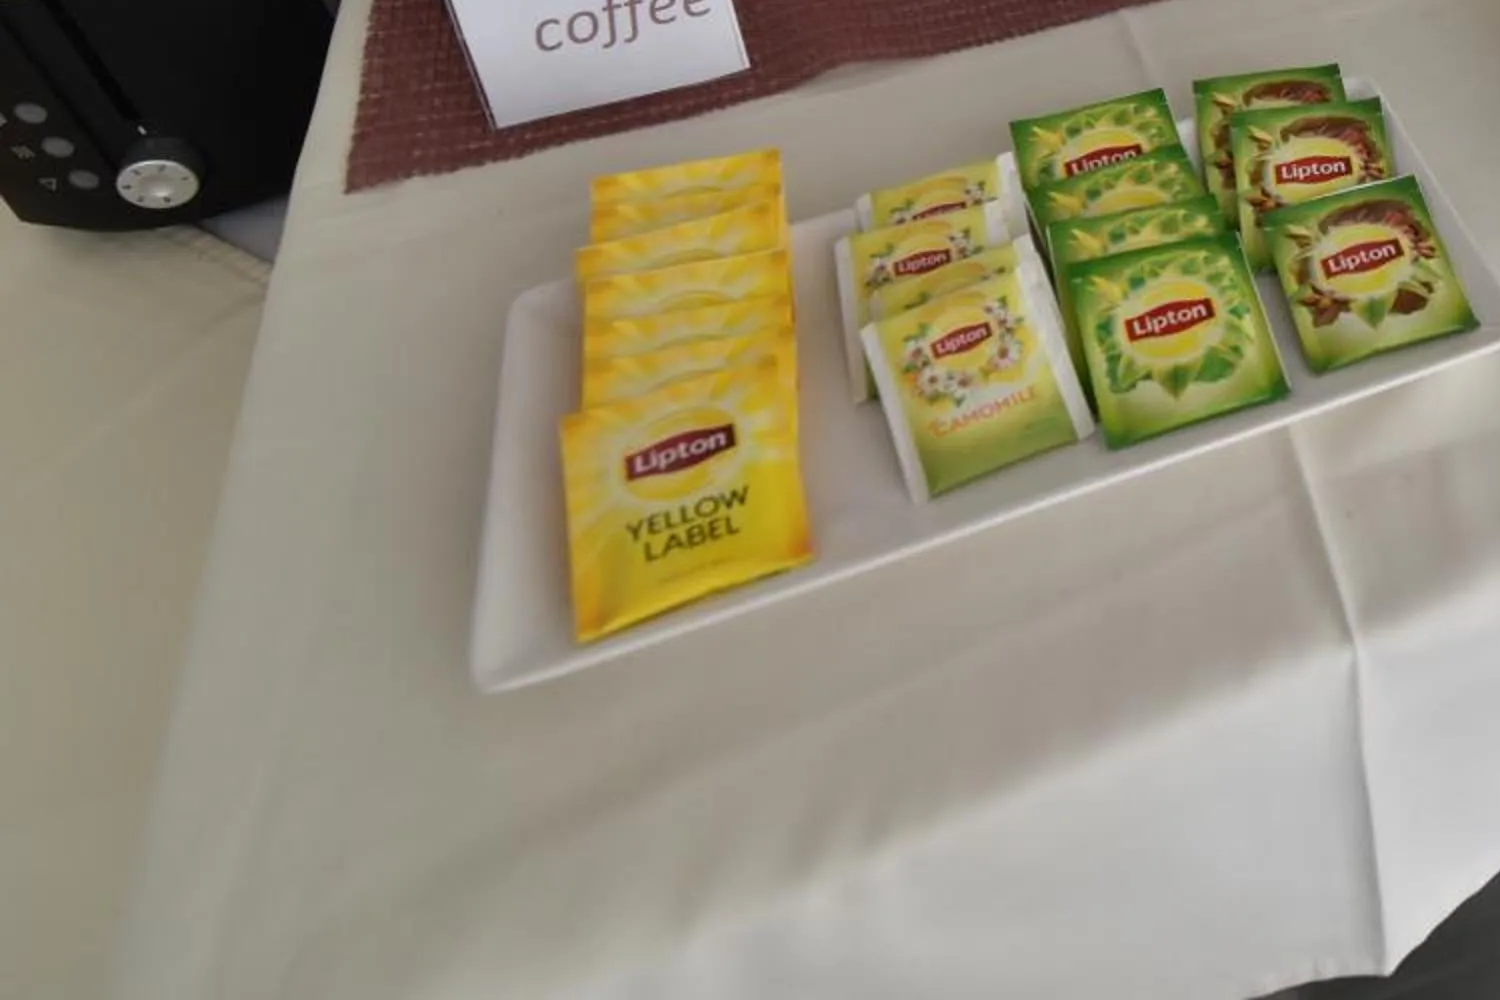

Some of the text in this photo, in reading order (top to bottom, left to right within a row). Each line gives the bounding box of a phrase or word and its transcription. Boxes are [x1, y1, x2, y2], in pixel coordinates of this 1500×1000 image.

[1281, 160, 1347, 181] Lipton
[896, 252, 948, 273] Lipton
[1327, 243, 1397, 273] Lipton
[1132, 303, 1208, 336] Lipton
[935, 326, 989, 355] Lipton
[633, 430, 728, 475] Lipton
[625, 484, 750, 543] YELLOW
[643, 515, 741, 562] LABEL
